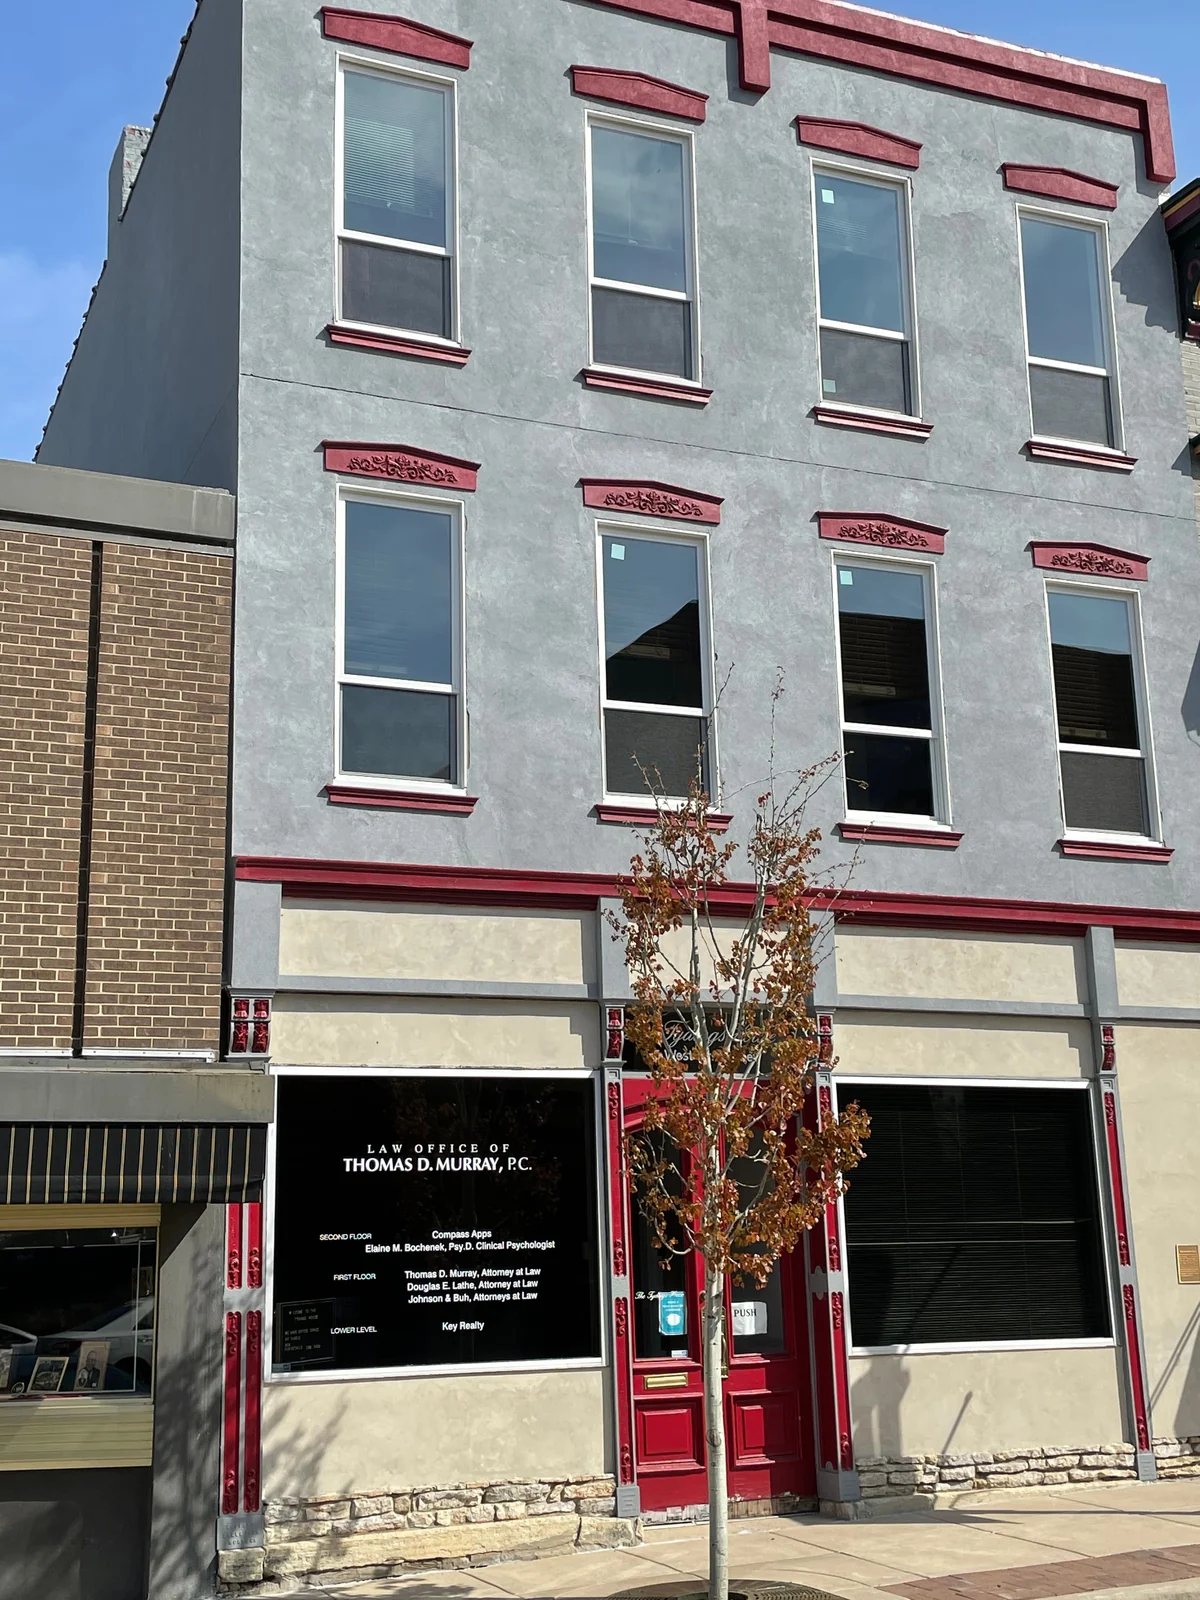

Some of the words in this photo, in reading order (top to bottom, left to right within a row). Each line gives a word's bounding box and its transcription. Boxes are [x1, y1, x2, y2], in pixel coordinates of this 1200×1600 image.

[367, 1144, 402, 1154] LAW
[414, 1144, 479, 1154] OFFICE
[489, 1143, 509, 1153] OF
[343, 1157, 413, 1172] THOMAS
[417, 1157, 434, 1172] D.
[435, 1157, 503, 1173] MURRAY,
[507, 1156, 533, 1171] P.C.
[319, 1233, 348, 1241] SECOND
[431, 1230, 470, 1240] Compass
[471, 1229, 492, 1239] Apps
[365, 1244, 391, 1253] Elaine
[392, 1244, 403, 1252] M.
[404, 1243, 447, 1252] Bochenek,
[448, 1242, 474, 1252] Psy.D.
[476, 1241, 505, 1249] Clinical
[506, 1240, 556, 1251] Psychologist
[333, 1273, 352, 1281] FIRST
[404, 1270, 437, 1279] Thomas
[438, 1269, 448, 1278] D.
[449, 1269, 480, 1279] Murray,
[481, 1268, 514, 1278] Attorney
[515, 1267, 524, 1276] at
[525, 1267, 541, 1275] Law
[407, 1282, 440, 1292] Douglas
[442, 1281, 451, 1290] E.
[452, 1280, 477, 1290] Lathe,
[478, 1280, 511, 1290] Attorney
[513, 1279, 521, 1288] at
[522, 1279, 539, 1287] Law
[408, 1295, 443, 1304] Johnson
[444, 1294, 452, 1303] &
[453, 1293, 472, 1303] Buh,
[473, 1292, 511, 1302] Attorneys
[512, 1292, 521, 1300] at
[522, 1291, 538, 1300] Law
[733, 1308, 757, 1318] PUSH
[330, 1327, 355, 1335] LOWER
[442, 1322, 458, 1332] Key
[459, 1321, 485, 1331] Realty
